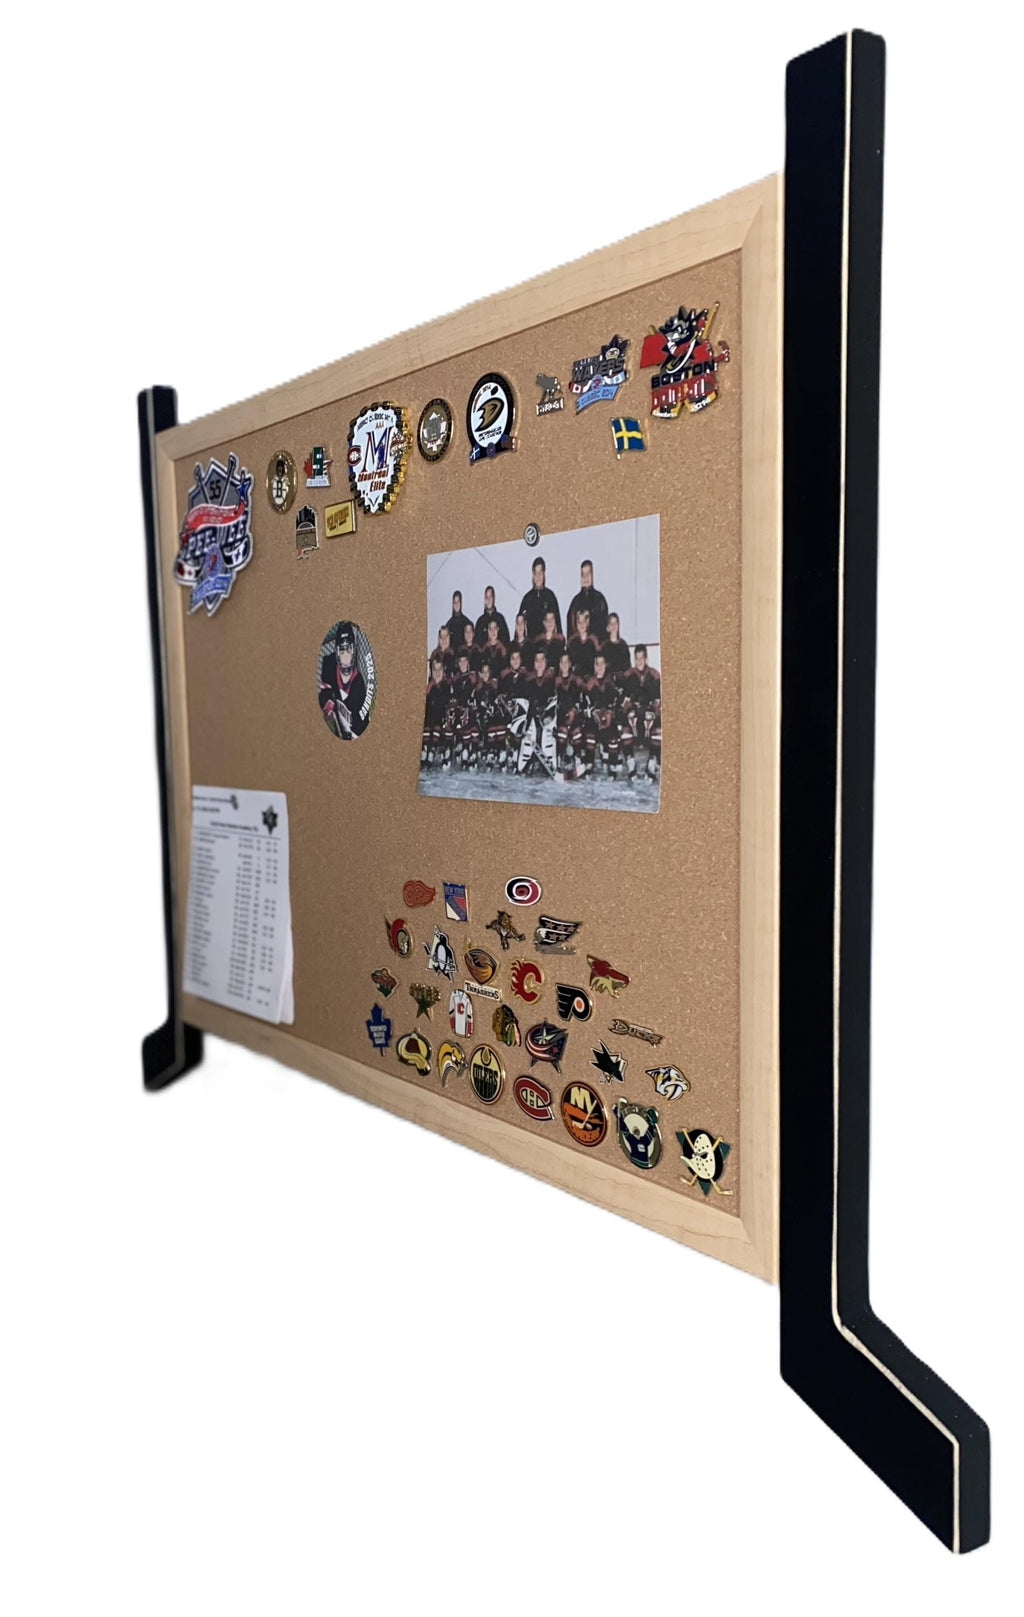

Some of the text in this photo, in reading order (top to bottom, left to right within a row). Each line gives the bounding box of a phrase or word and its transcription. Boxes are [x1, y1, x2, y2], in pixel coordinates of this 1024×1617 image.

[651, 359, 715, 389] BOSTON
[360, 425, 394, 473] M
[358, 467, 389, 482] Montreal
[370, 480, 386, 492] Elite
[209, 479, 222, 500] 55
[276, 480, 283, 498] B
[359, 652, 375, 721] BANDITS 2025
[472, 1062, 499, 1087] OILERS
